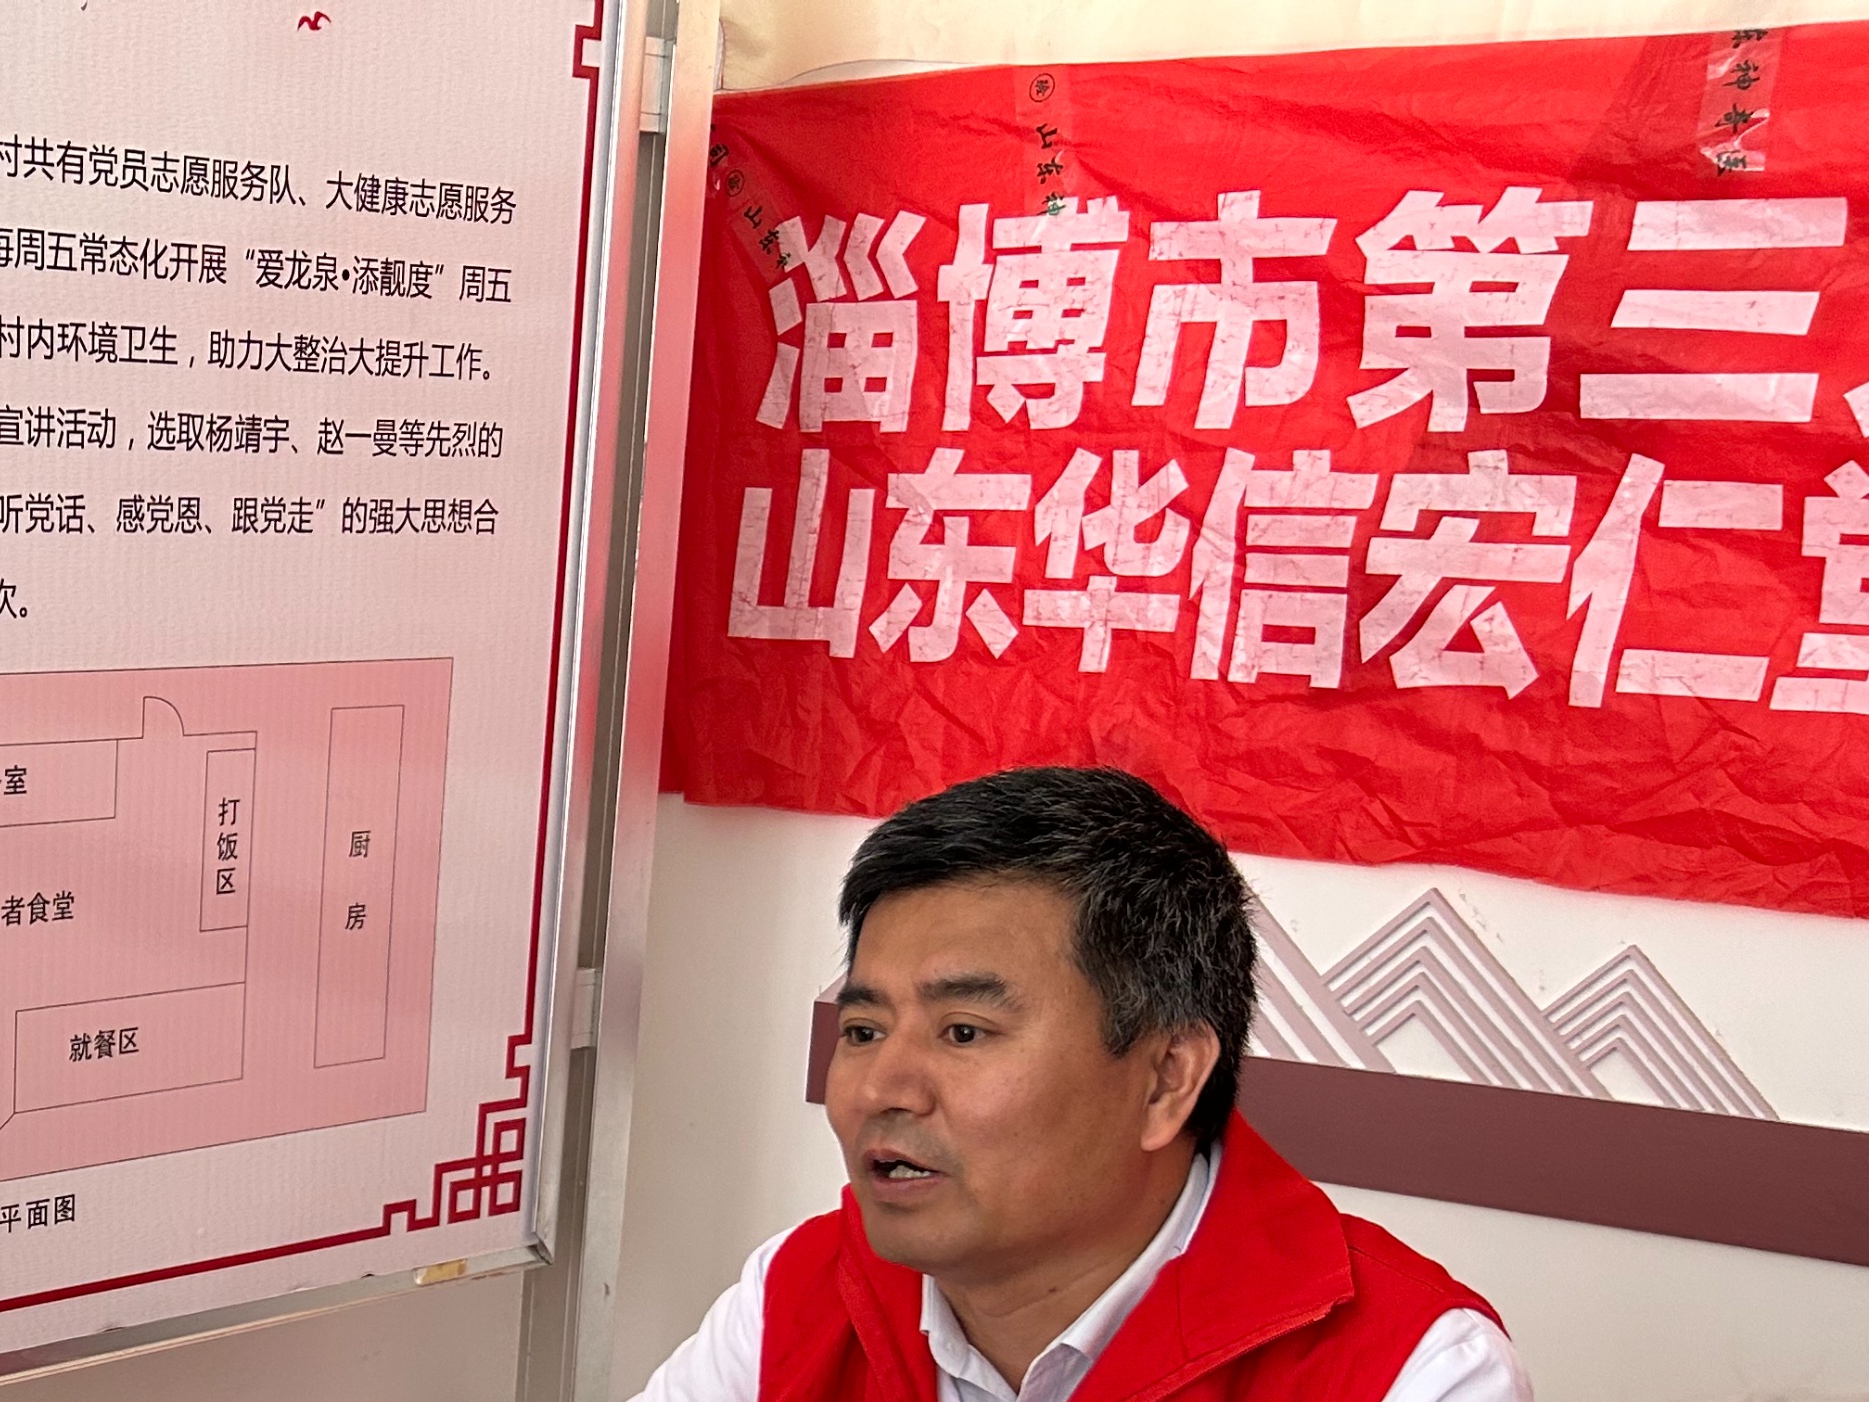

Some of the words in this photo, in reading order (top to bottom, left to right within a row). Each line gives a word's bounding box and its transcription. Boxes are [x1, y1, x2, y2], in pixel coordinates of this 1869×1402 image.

[755, 187, 1869, 434] 淄博市第三
[216, 797, 241, 895] 打饭区
[69, 1026, 140, 1063] 就餐区
